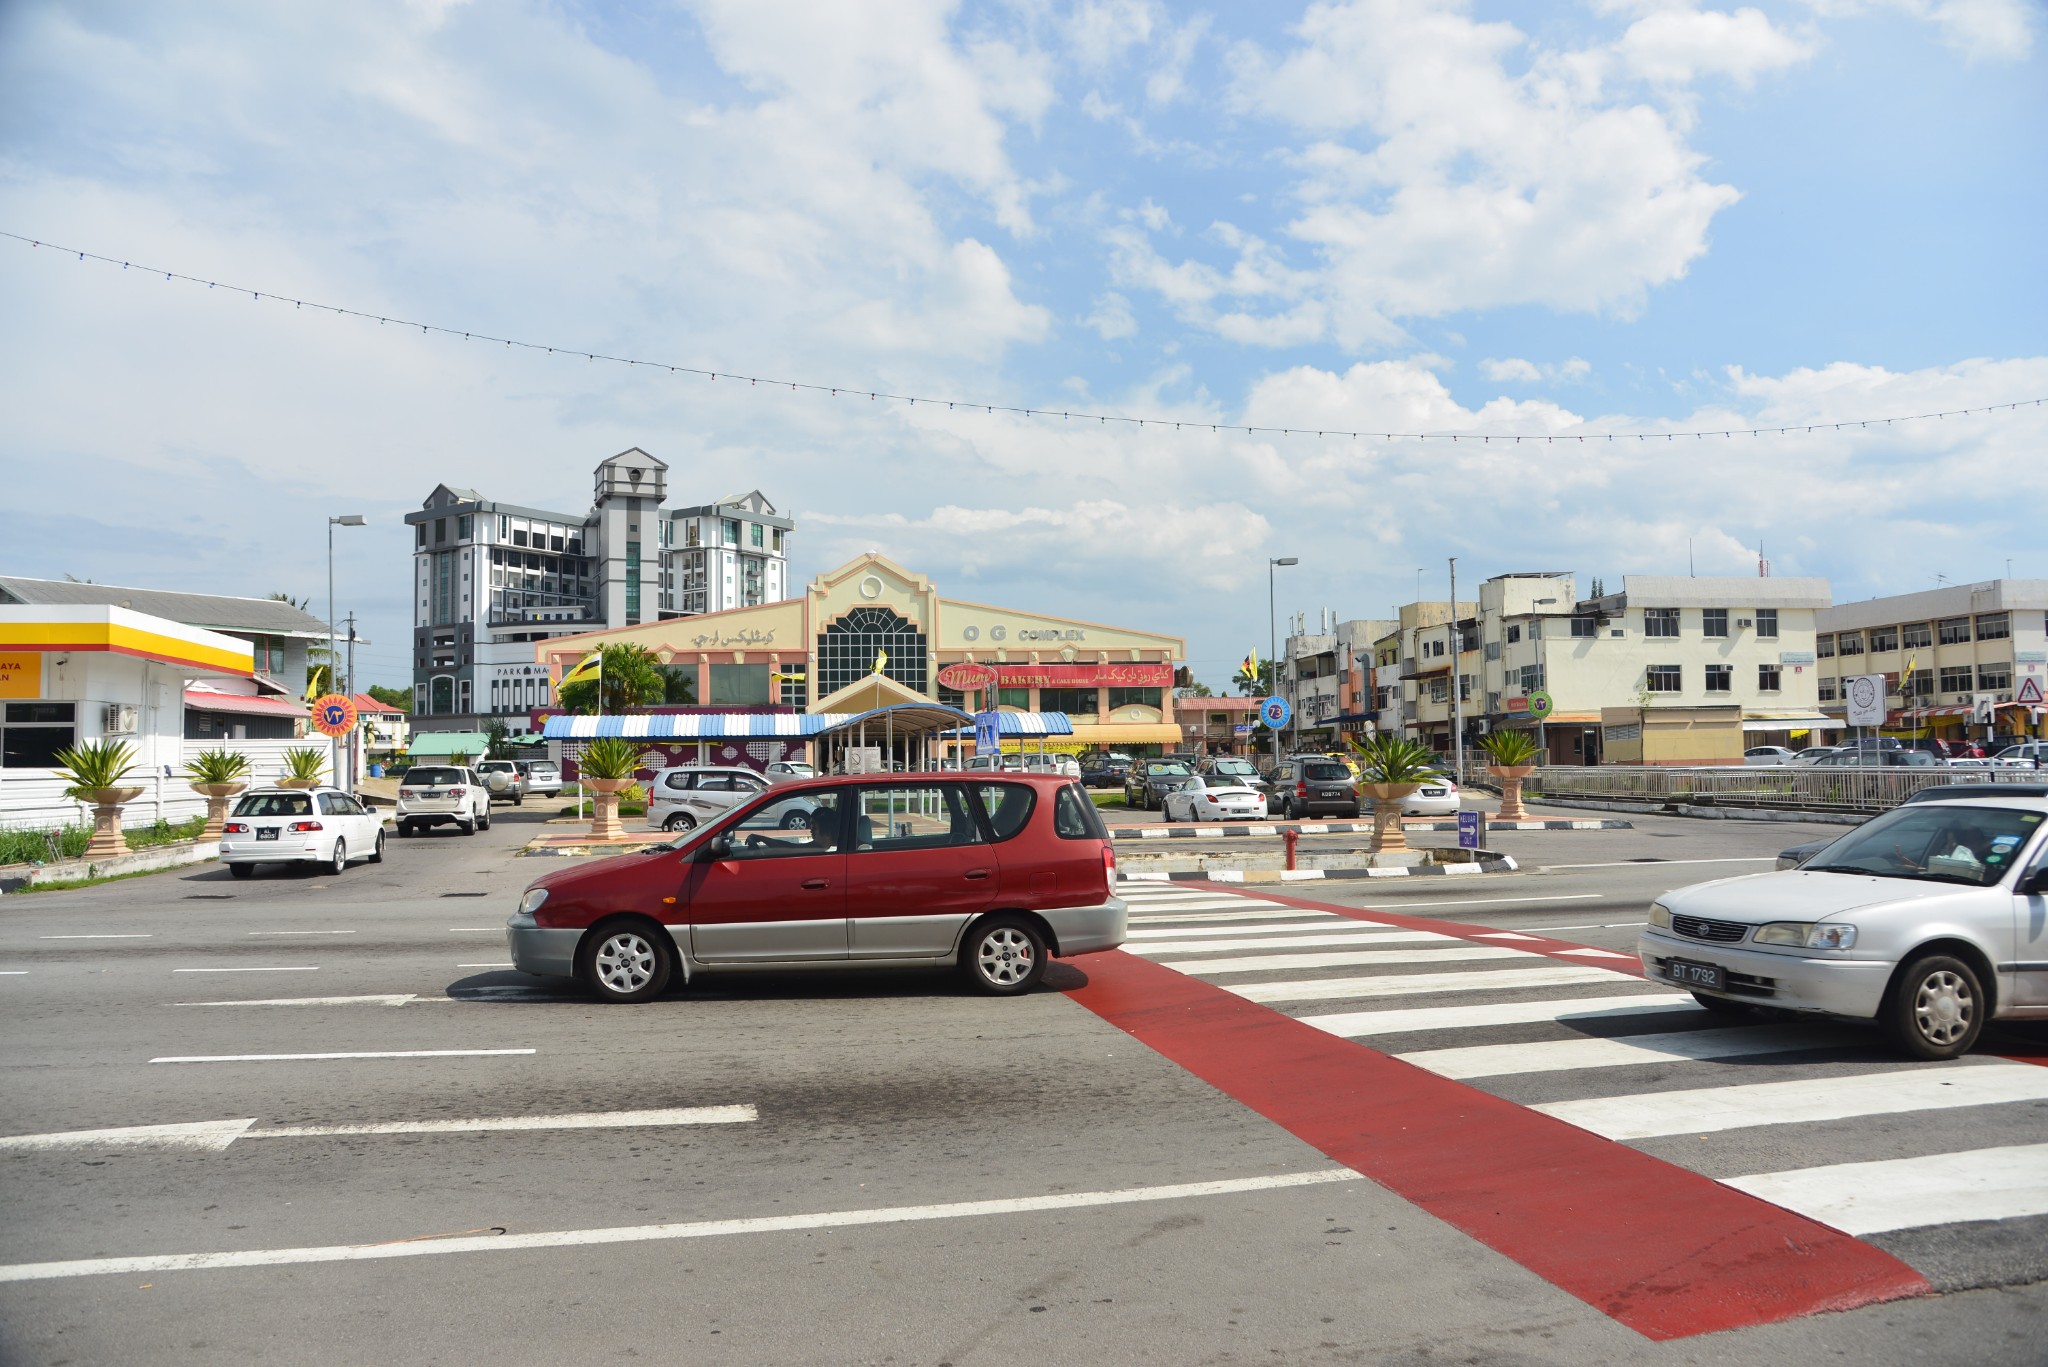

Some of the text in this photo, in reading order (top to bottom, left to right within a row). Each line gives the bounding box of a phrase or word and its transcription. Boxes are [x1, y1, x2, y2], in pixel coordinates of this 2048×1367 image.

[964, 625, 1086, 642] O G COMPLEX
[497, 668, 521, 676] PARK
[1000, 675, 1051, 685] BAKERY
[1270, 707, 1282, 718] 73
[1464, 836, 1472, 845] OUT
[1674, 964, 1716, 984] BT 1792
